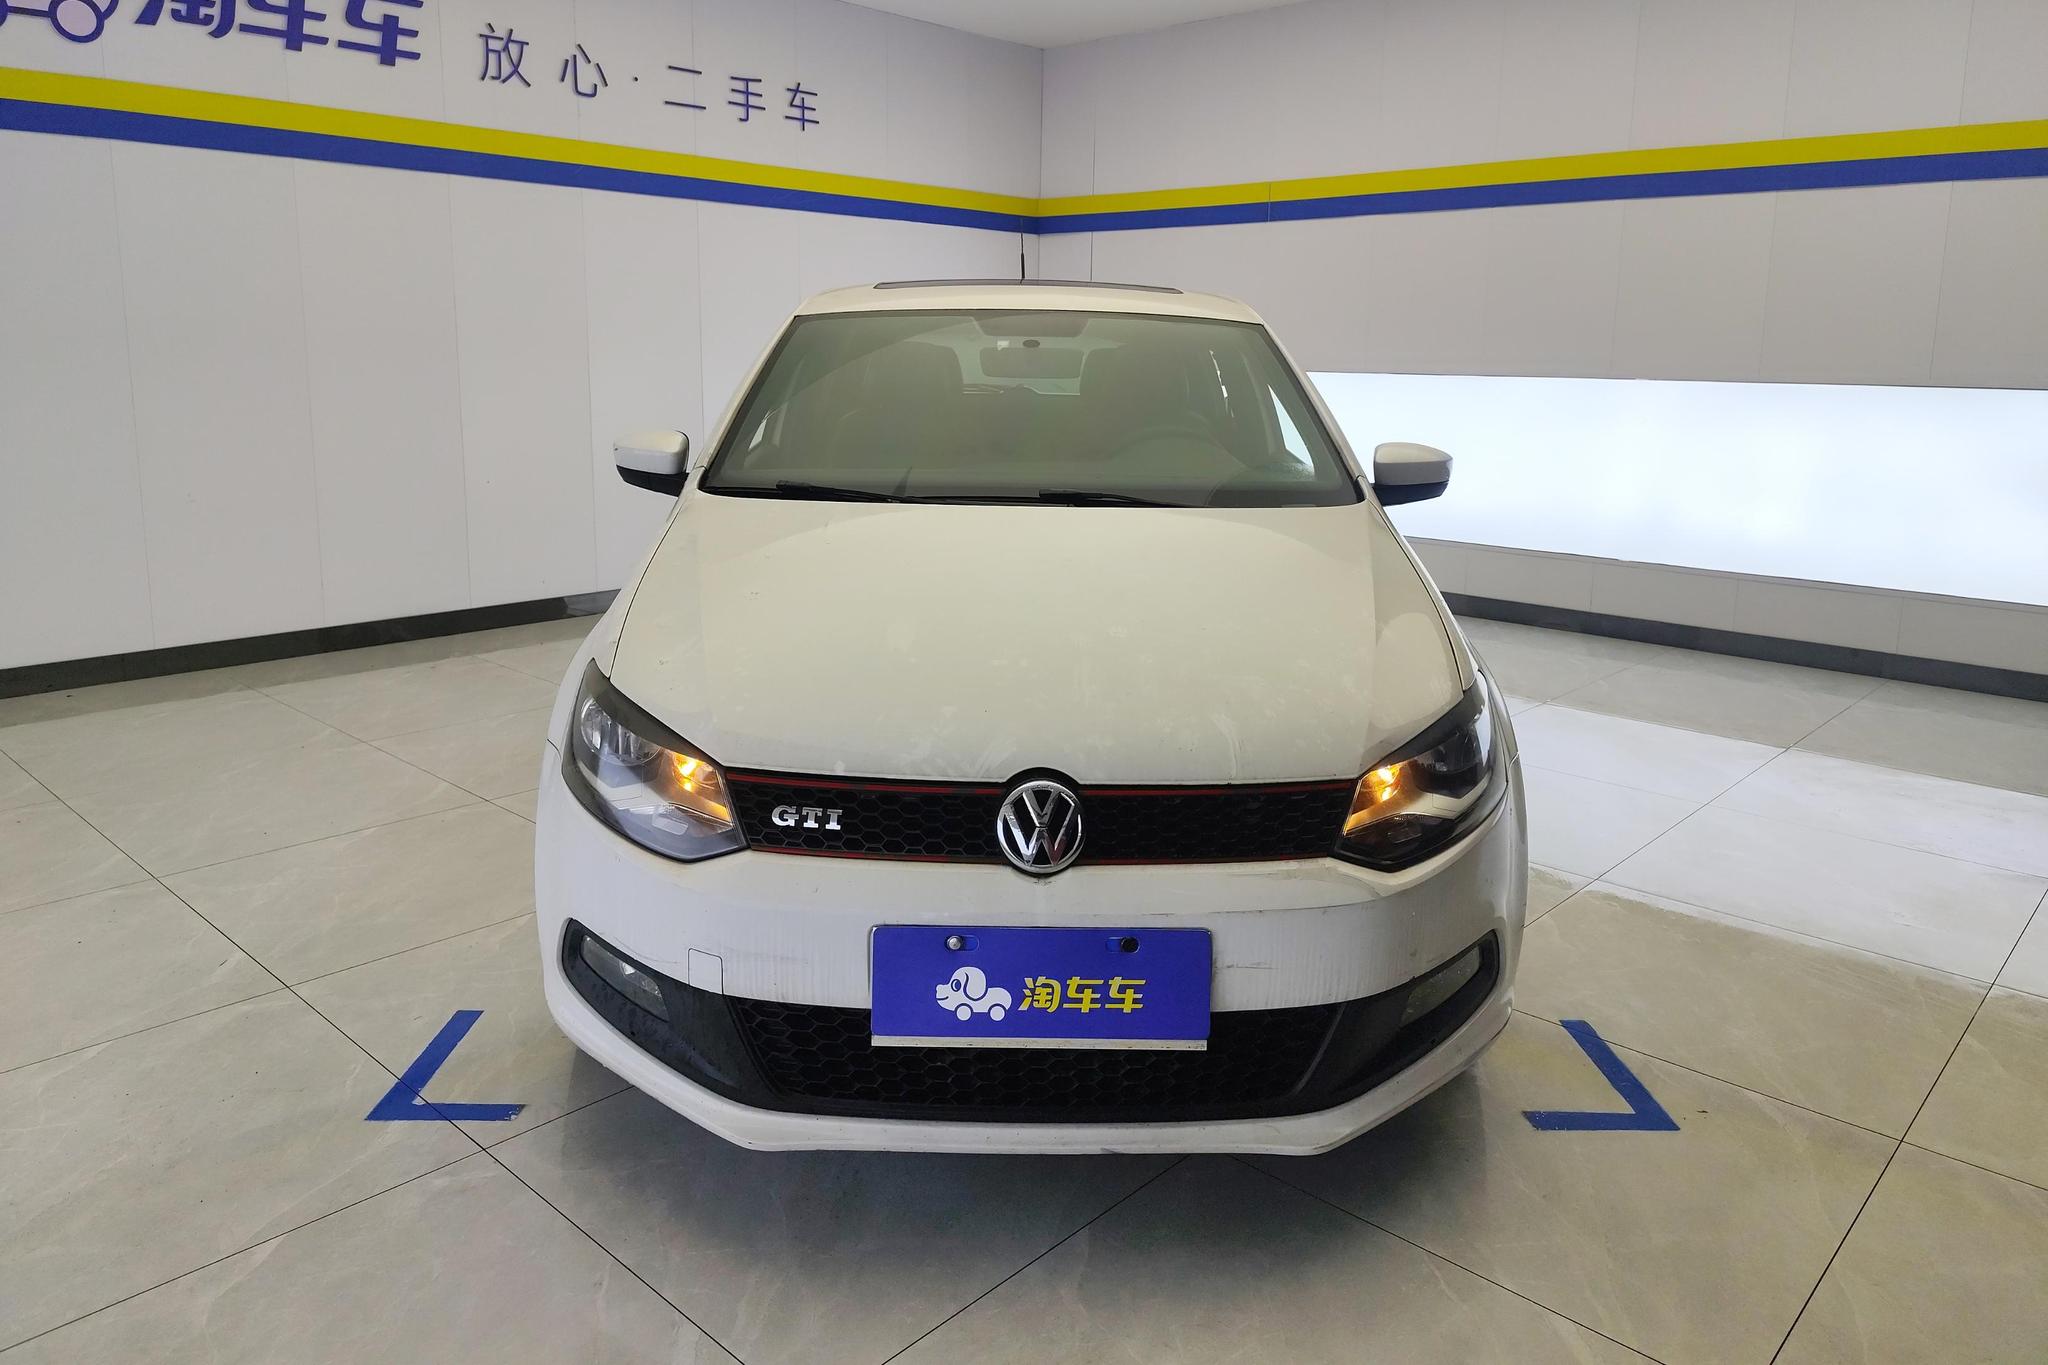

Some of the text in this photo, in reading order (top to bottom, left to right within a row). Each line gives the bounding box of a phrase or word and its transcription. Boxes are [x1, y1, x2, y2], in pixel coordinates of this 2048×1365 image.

[771, 805, 843, 831] GTI
[1018, 976, 1146, 1013] 淘车车
